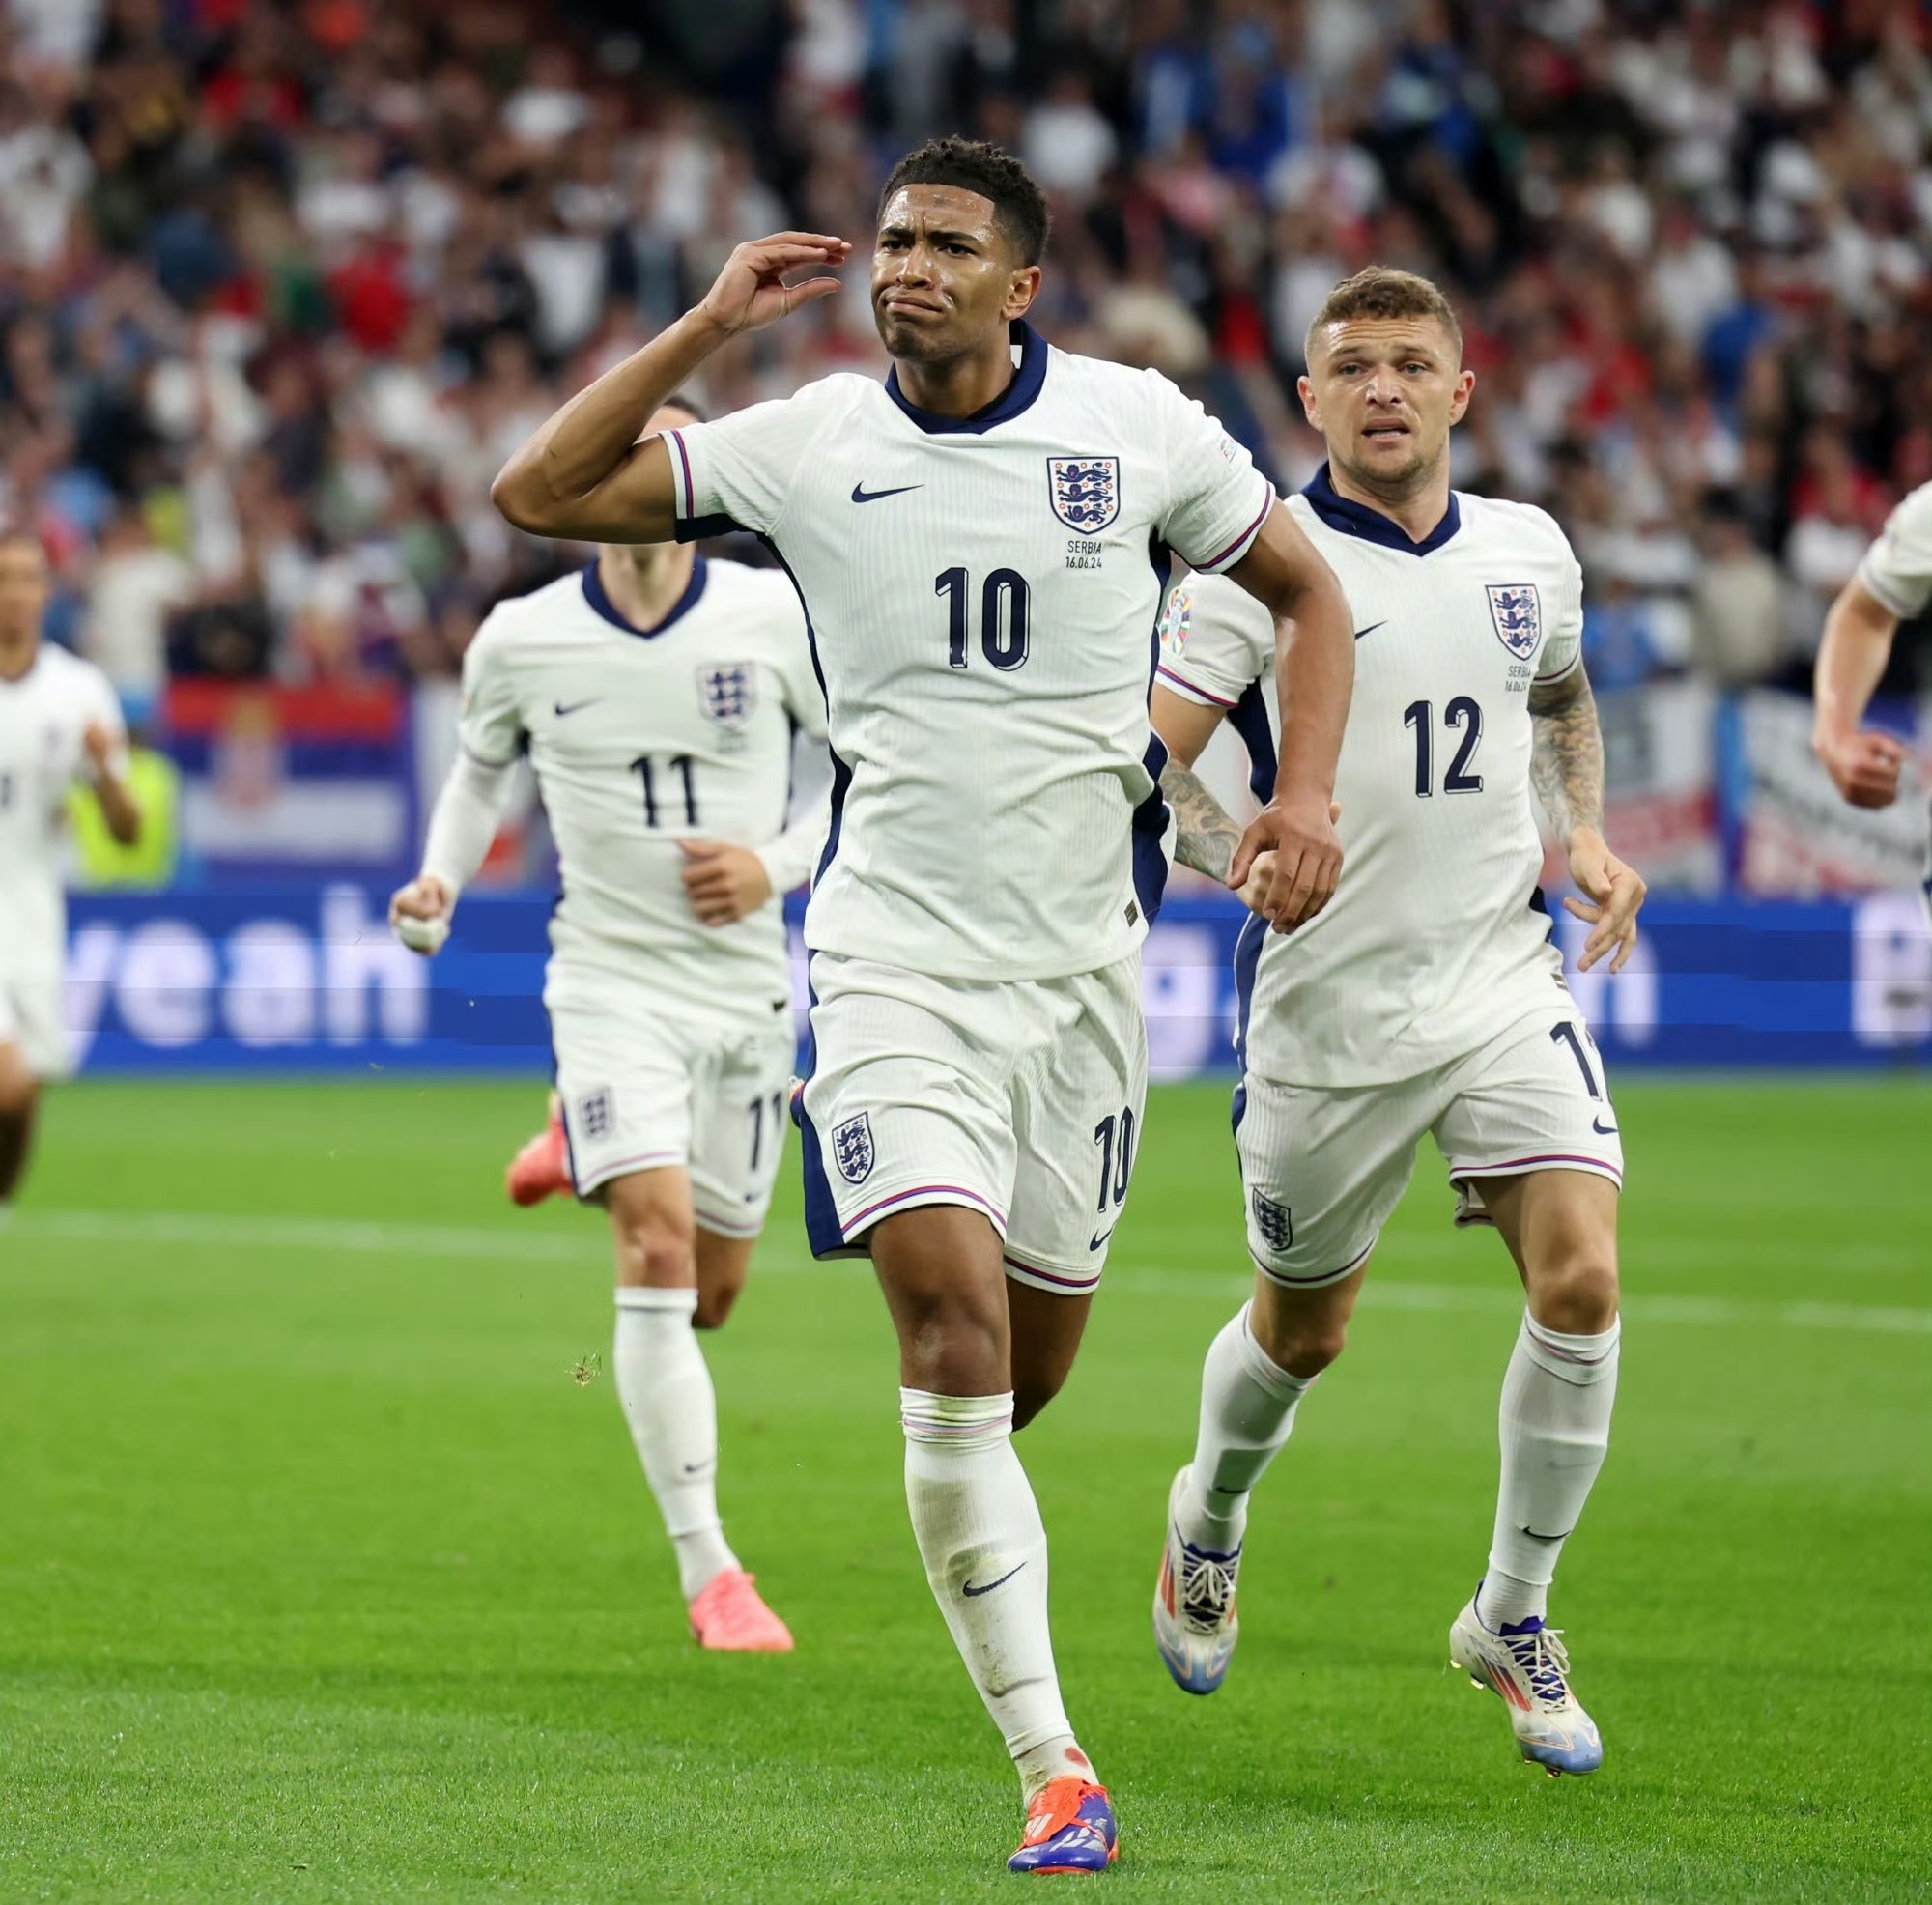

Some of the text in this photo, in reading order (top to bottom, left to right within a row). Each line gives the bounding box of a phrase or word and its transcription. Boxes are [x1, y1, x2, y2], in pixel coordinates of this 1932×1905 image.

[1065, 556, 1102, 569] 16.06.24
[1067, 540, 1102, 554] SERBIA
[934, 566, 1031, 672] 10
[1404, 696, 1484, 799] 12
[628, 753, 701, 829] 11
[1548, 1020, 1605, 1102] 1
[749, 1091, 783, 1172] 11
[1094, 1104, 1135, 1214] 10
